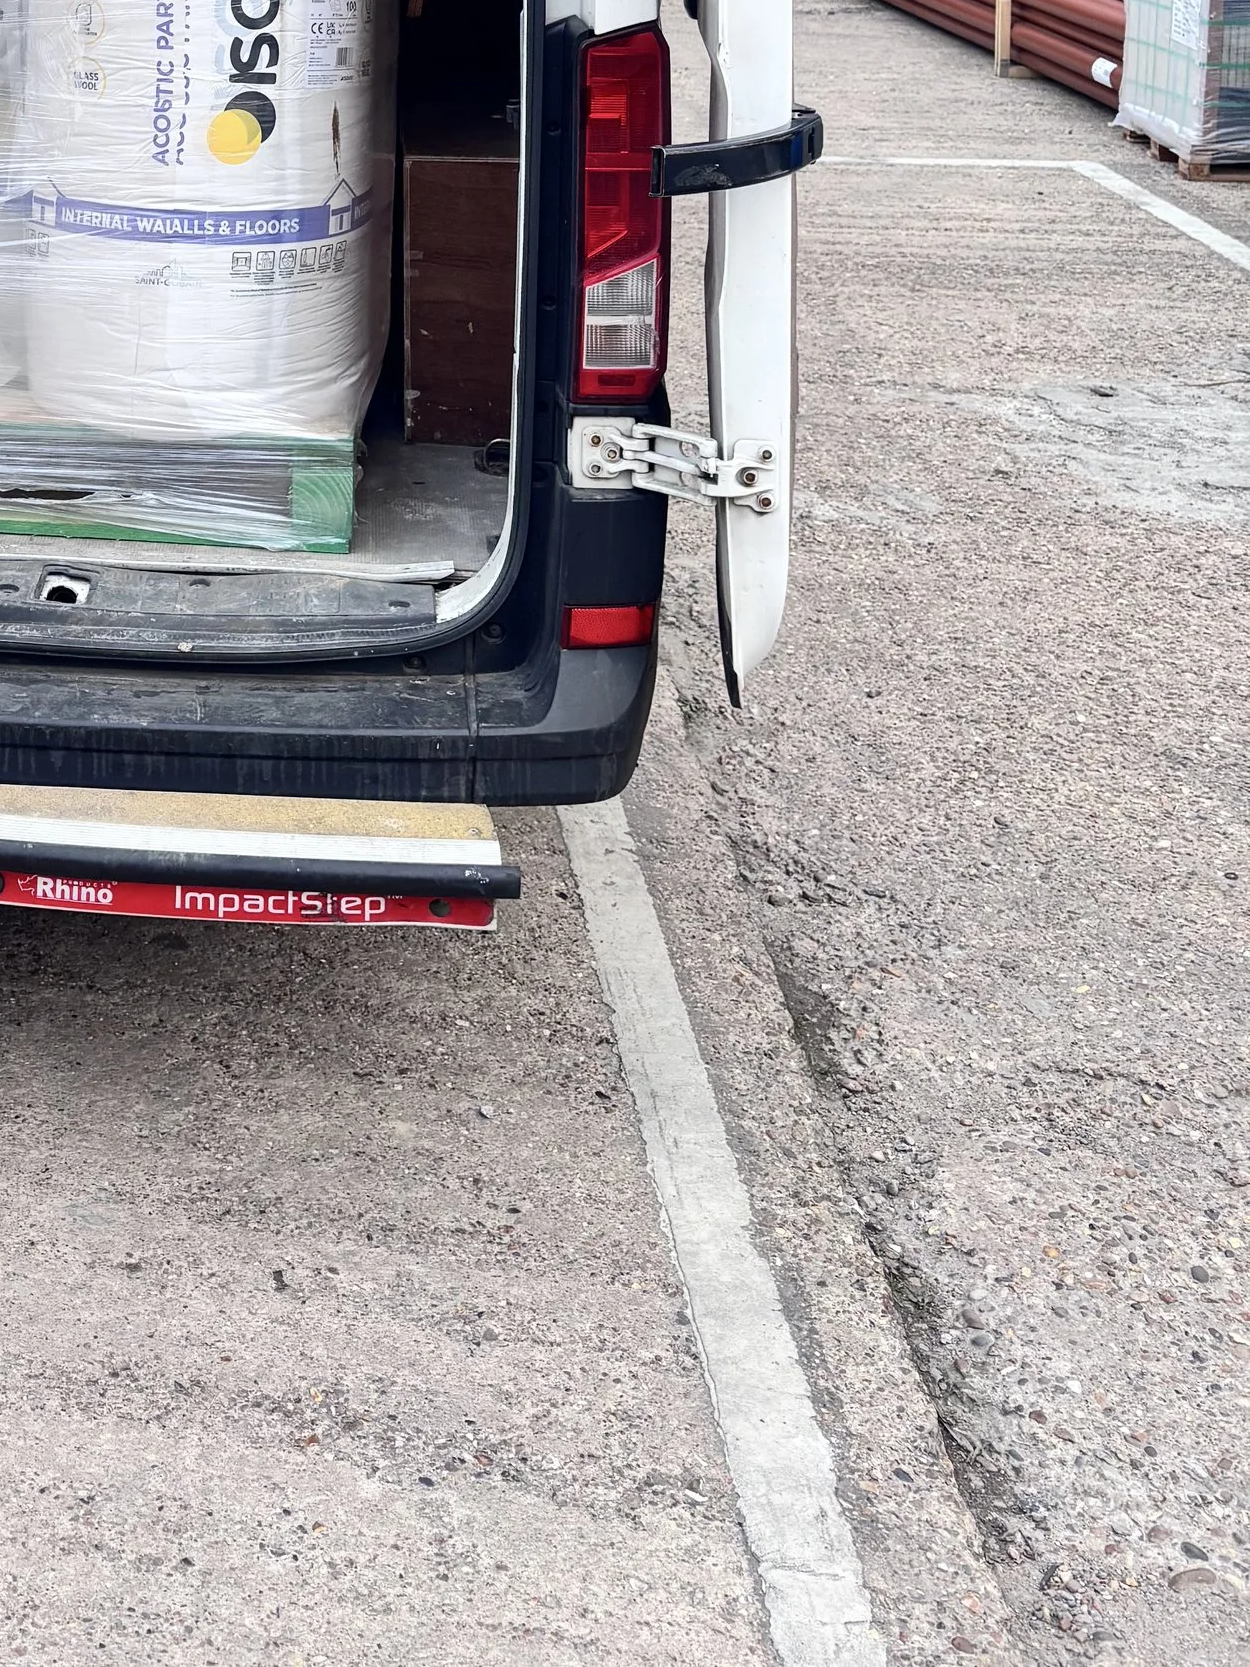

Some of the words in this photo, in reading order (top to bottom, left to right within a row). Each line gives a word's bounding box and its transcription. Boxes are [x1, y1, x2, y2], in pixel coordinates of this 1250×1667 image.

[219, 220, 231, 235] &
[235, 218, 300, 236] FLOORS
[36, 876, 113, 904] Rhino
[175, 885, 386, 922] ImpactStep
